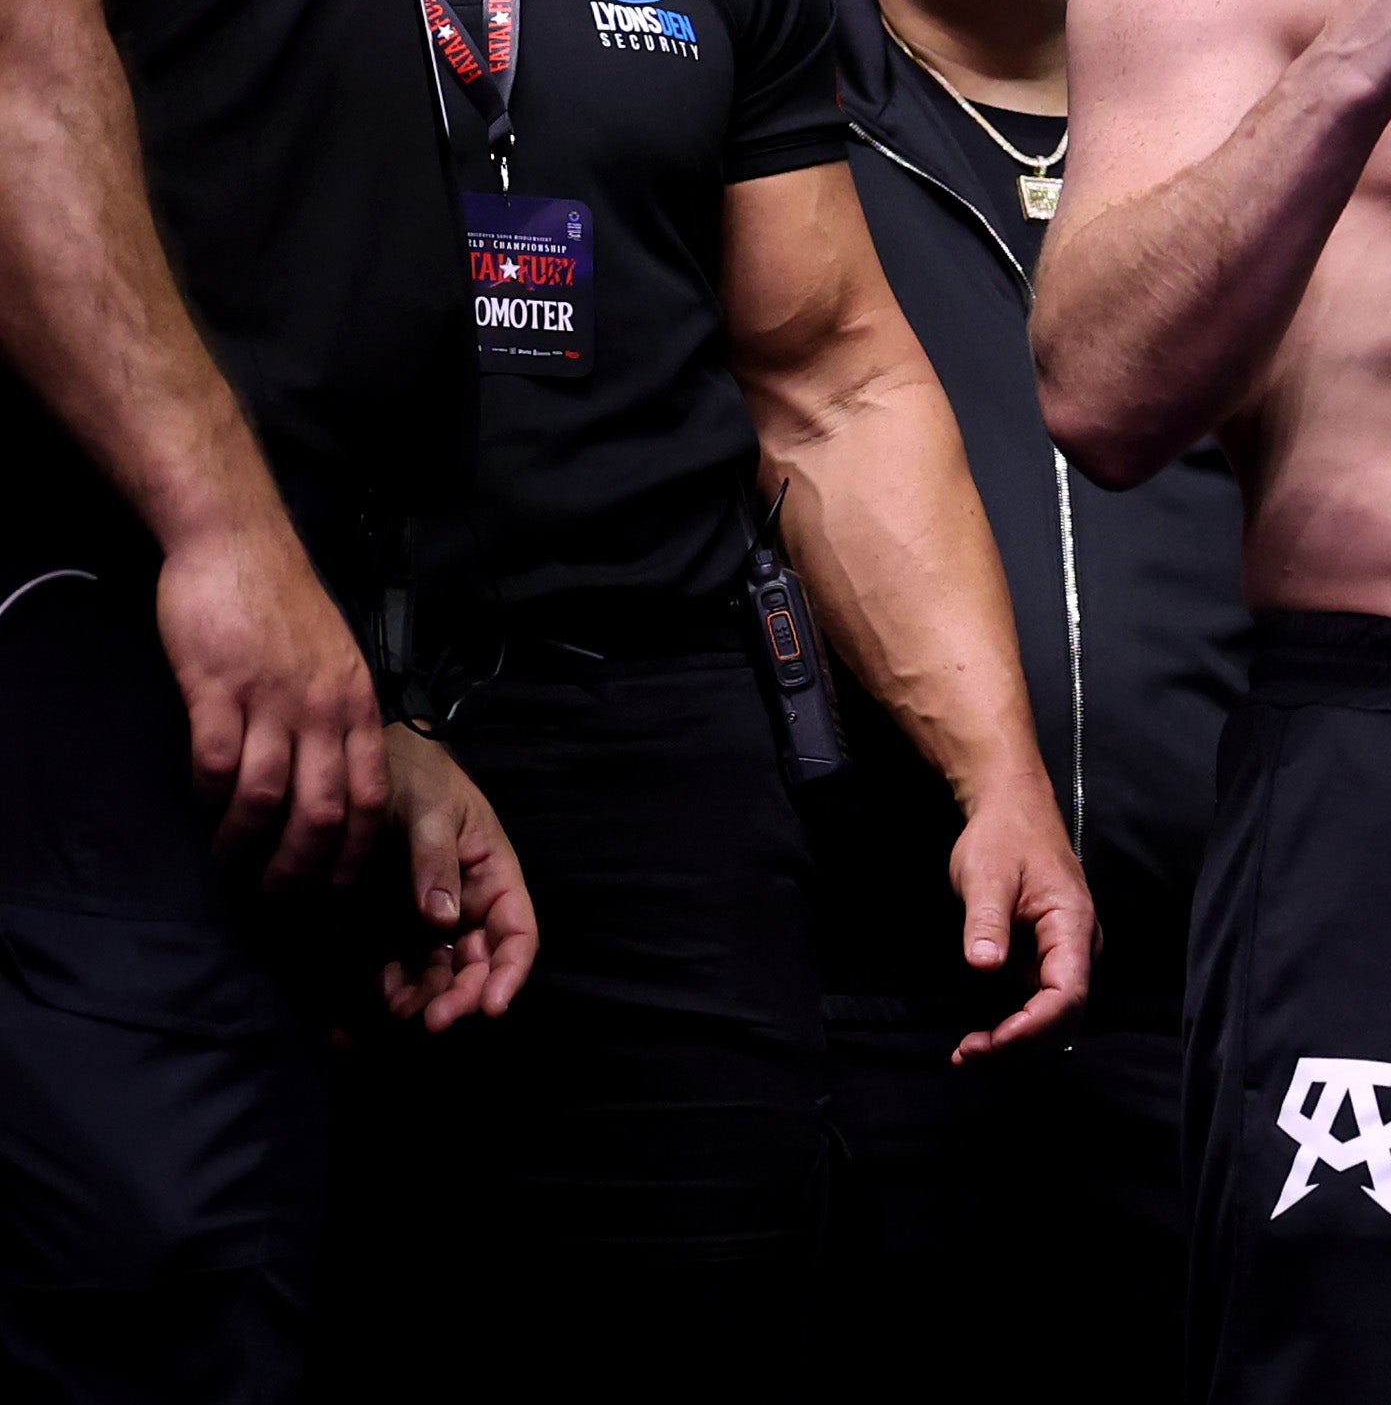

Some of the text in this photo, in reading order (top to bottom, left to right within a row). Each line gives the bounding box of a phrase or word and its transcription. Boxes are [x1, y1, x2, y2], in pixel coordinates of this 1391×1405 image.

[590, 1, 697, 43] LYONSDEN
[487, 16, 513, 74] FATAL
[599, 32, 699, 61] SECURITY
[493, 239, 567, 254] CHAMPIONSHIP
[469, 251, 578, 287] TAL FURY
[475, 295, 575, 332] OMOTER
